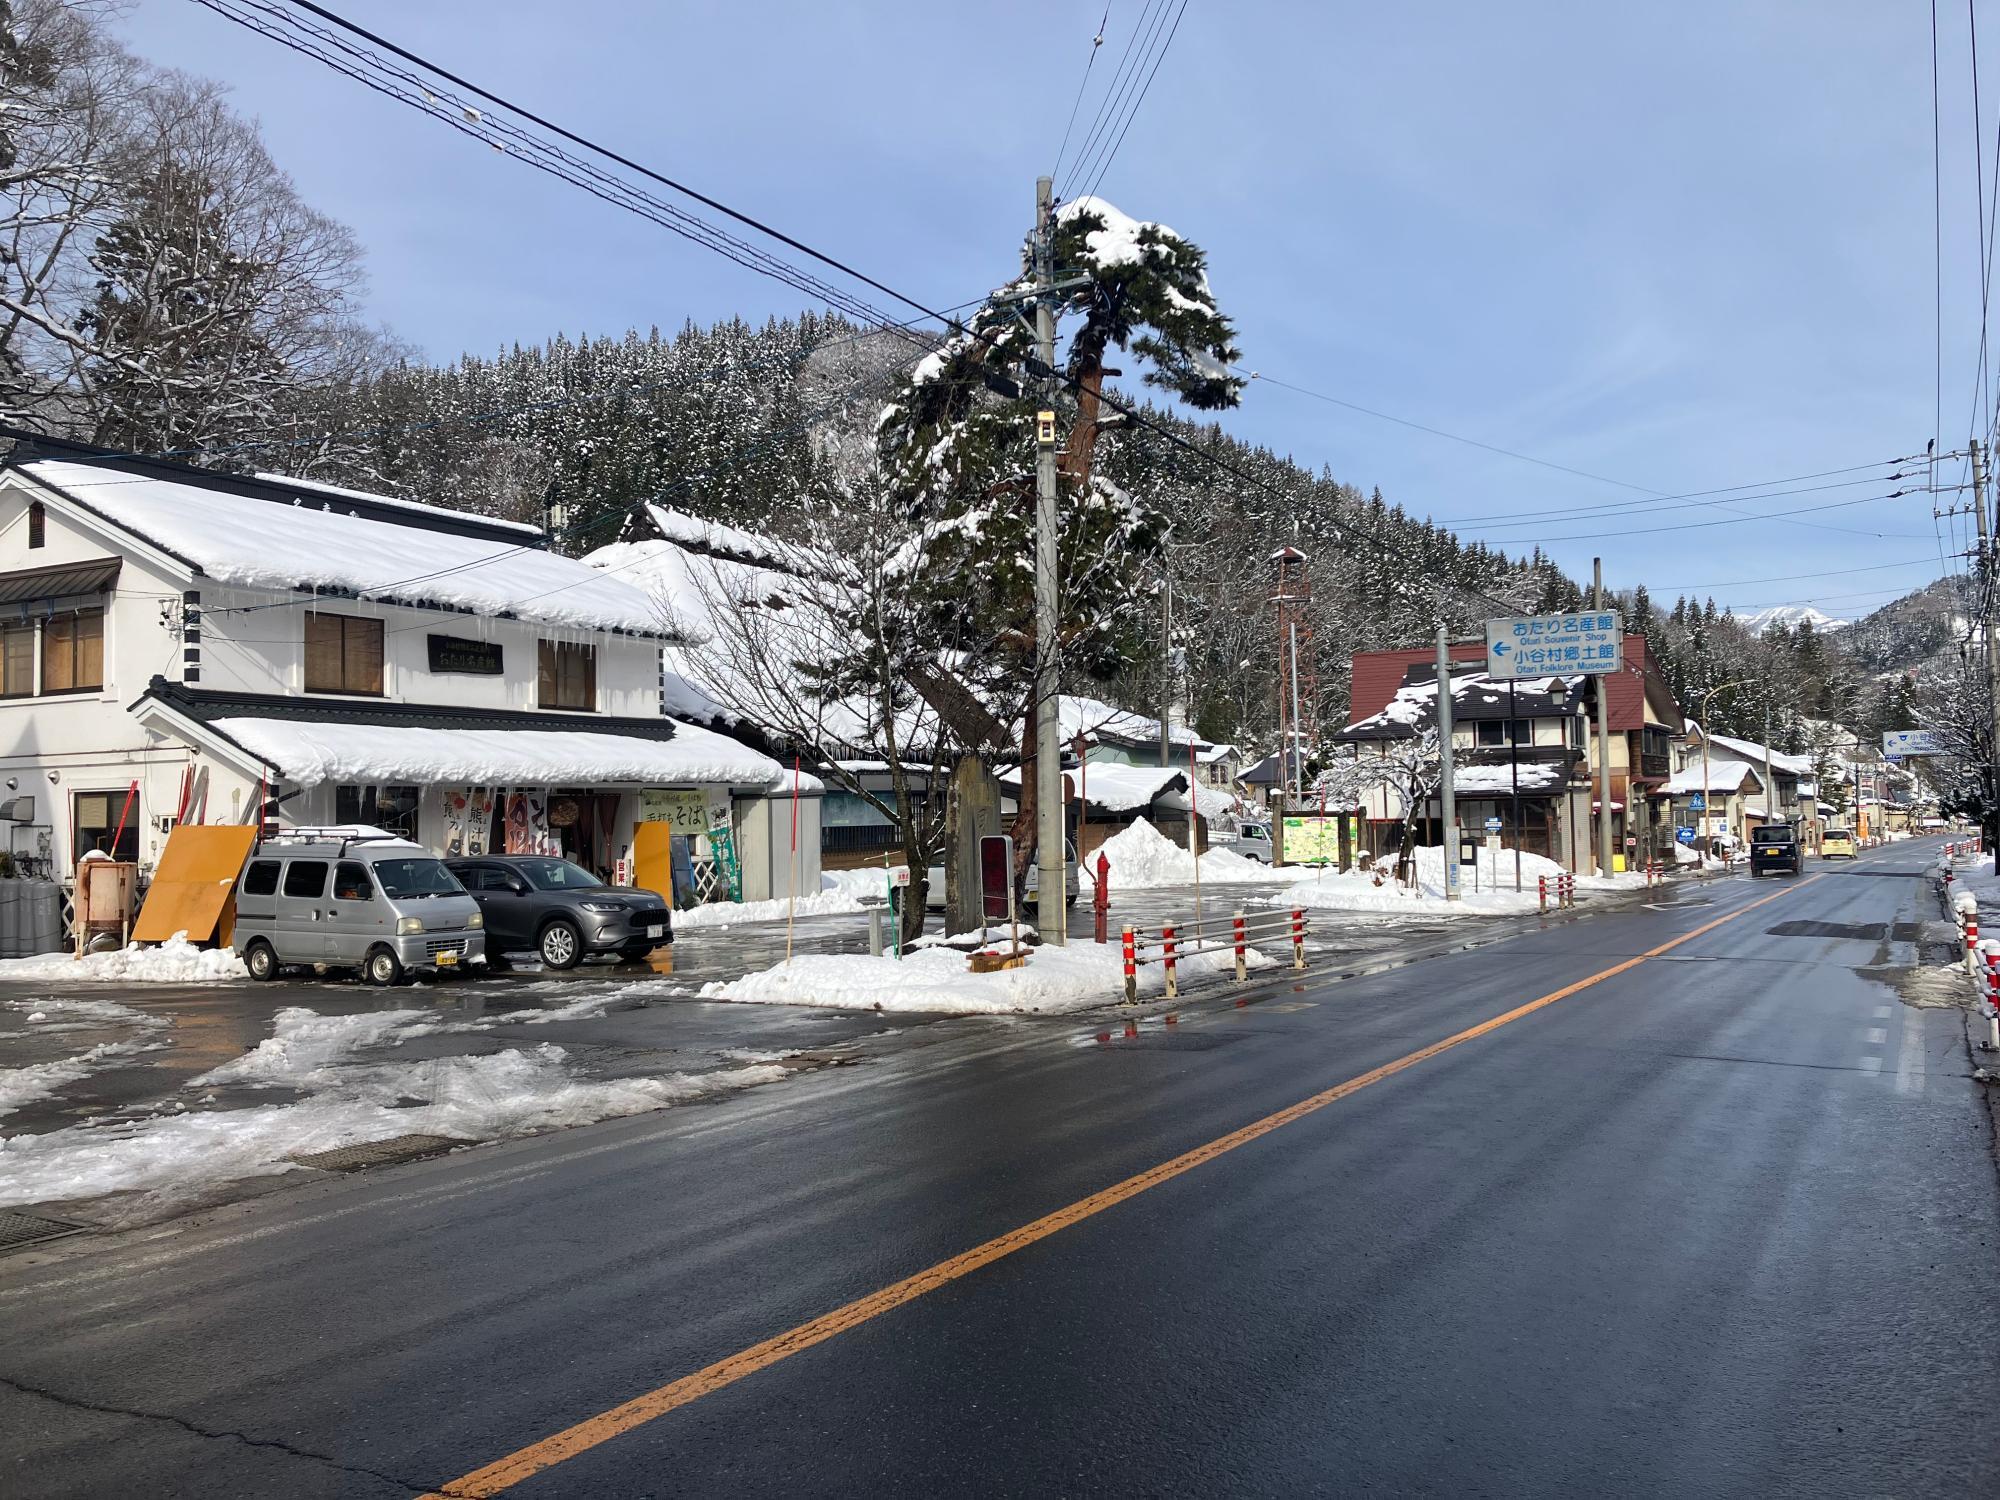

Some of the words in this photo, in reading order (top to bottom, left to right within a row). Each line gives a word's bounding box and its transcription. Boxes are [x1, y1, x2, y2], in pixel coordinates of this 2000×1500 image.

[1513, 615, 1613, 636] おたり名産館
[1520, 637, 1541, 646] Otari
[1545, 634, 1581, 644] Souvenir
[1585, 633, 1607, 642] Shop
[1514, 644, 1615, 664] 小谷村郷土館
[1516, 665, 1537, 674] Otari
[1540, 663, 1574, 672] Folklore
[1577, 661, 1614, 670] Museum
